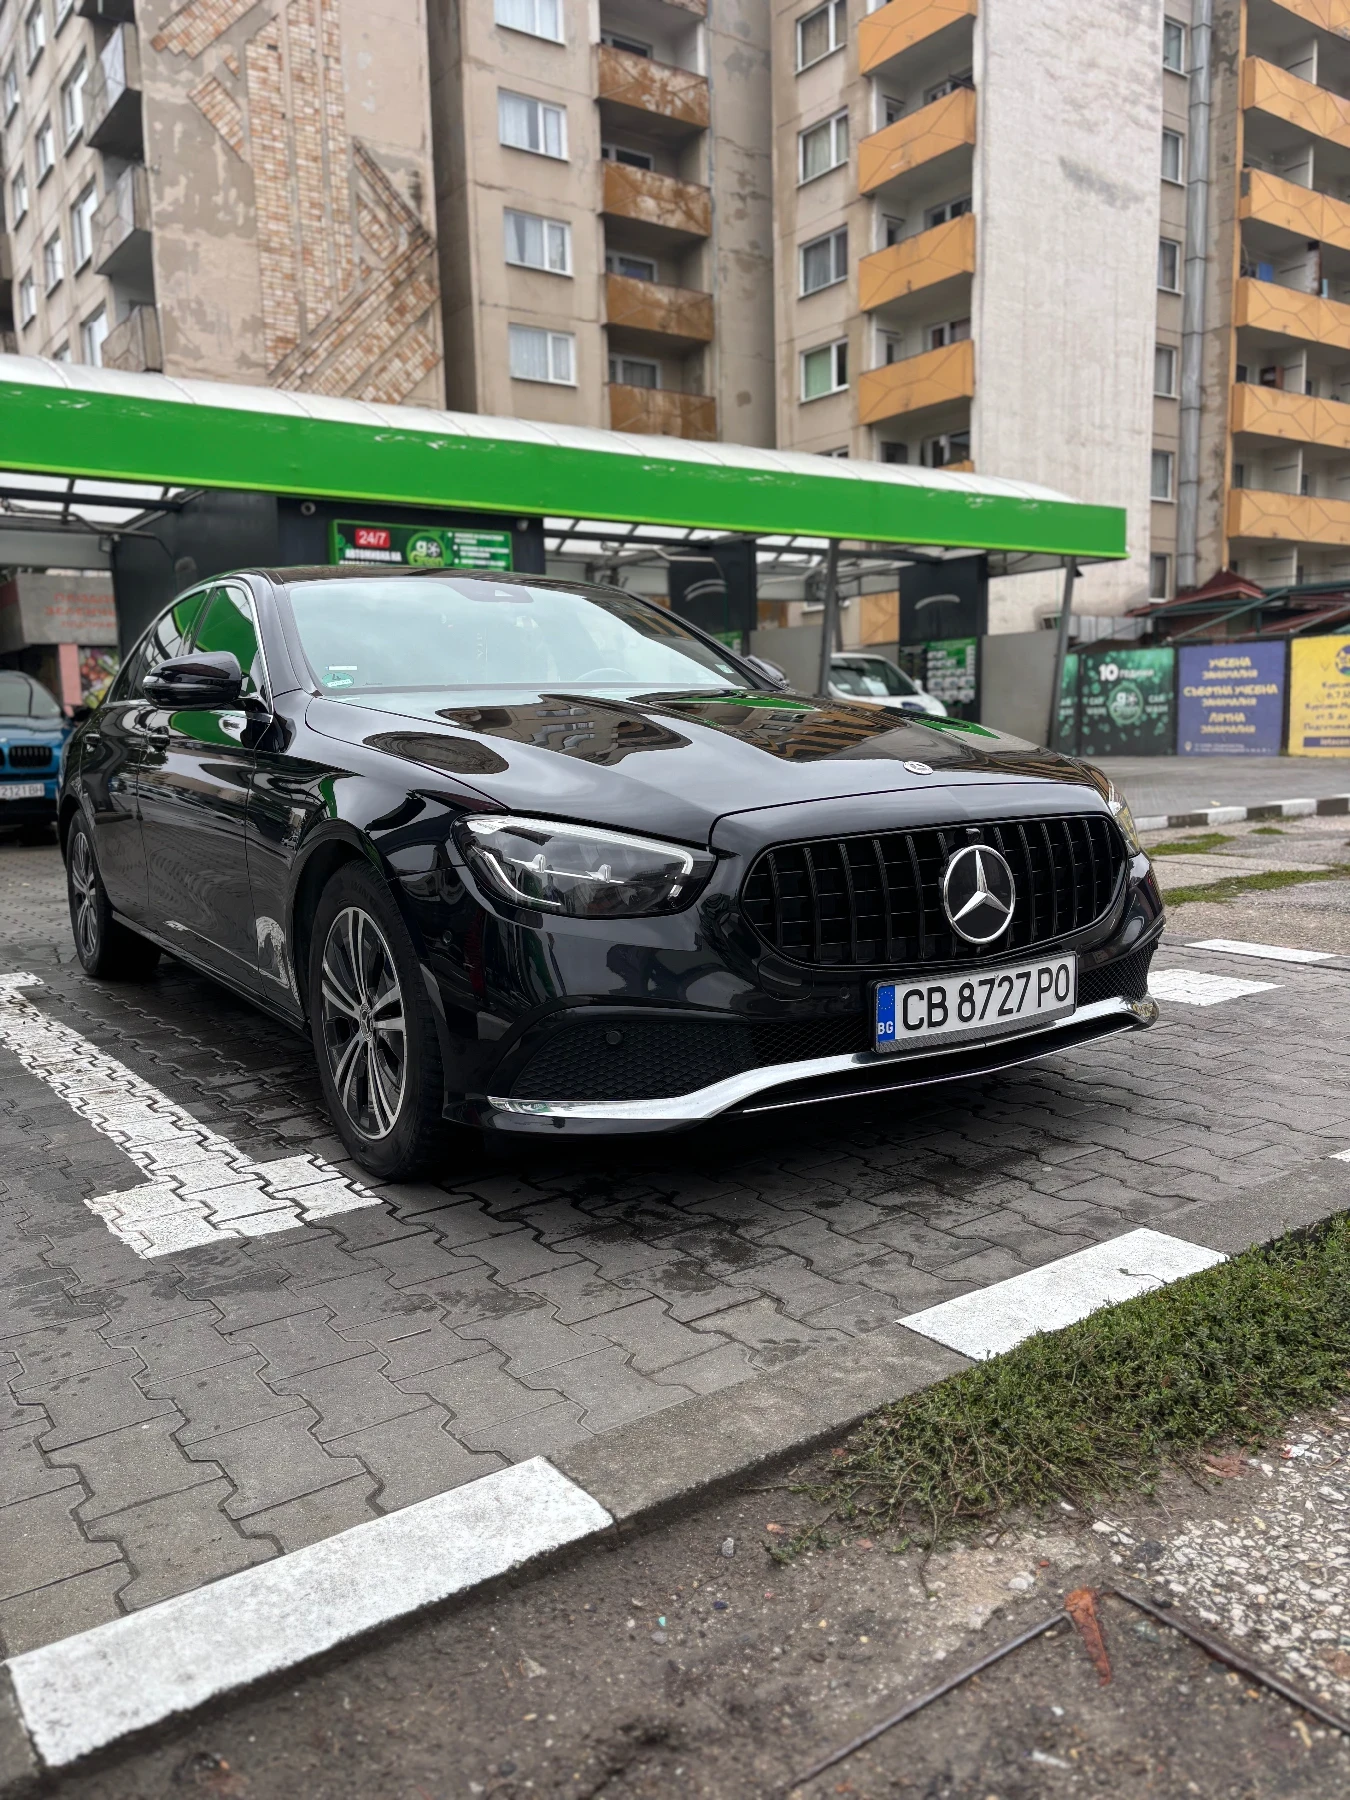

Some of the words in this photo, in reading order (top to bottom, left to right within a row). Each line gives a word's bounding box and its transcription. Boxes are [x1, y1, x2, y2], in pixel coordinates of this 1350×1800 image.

[359, 531, 386, 545] 24/7
[345, 548, 390, 561] АВТОМИВКА
[1209, 656, 1251, 668] УЧЕБНА
[1099, 664, 1118, 681] 10
[1120, 669, 1154, 679] ГОДИНИ
[1183, 685, 1233, 697] СЪБОТНА
[1234, 683, 1278, 696] УЧЕБНА
[1208, 712, 1246, 723] ЛЯТНА
[902, 985, 949, 1031] CB
[957, 970, 1031, 1023] 8727
[1037, 963, 1070, 1008] PO
[877, 1021, 894, 1035] BG
